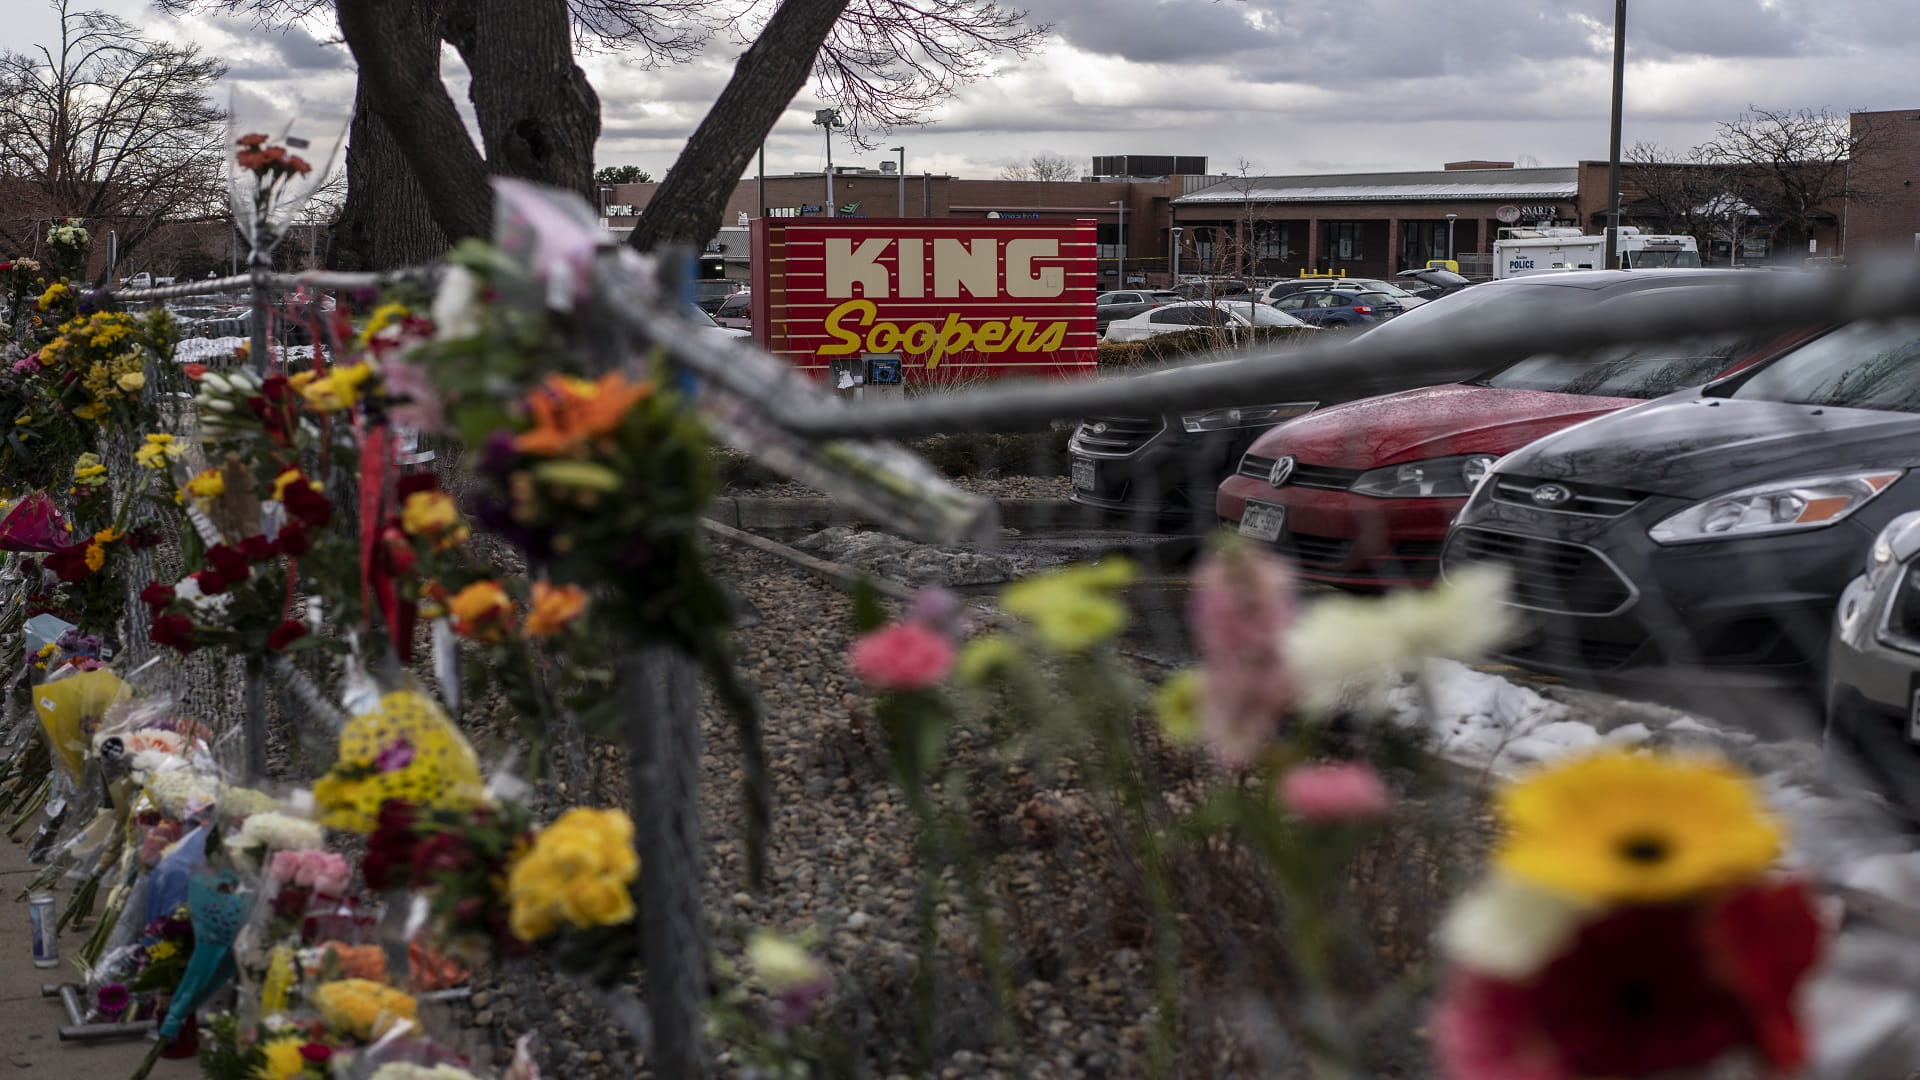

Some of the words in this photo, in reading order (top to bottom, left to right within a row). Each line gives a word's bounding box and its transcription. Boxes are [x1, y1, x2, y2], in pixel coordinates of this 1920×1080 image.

[606, 205, 633, 216] NEPTUNE
[825, 238, 1064, 298] KING
[1509, 260, 1534, 269] POLICE
[816, 299, 1068, 369] Soopers
